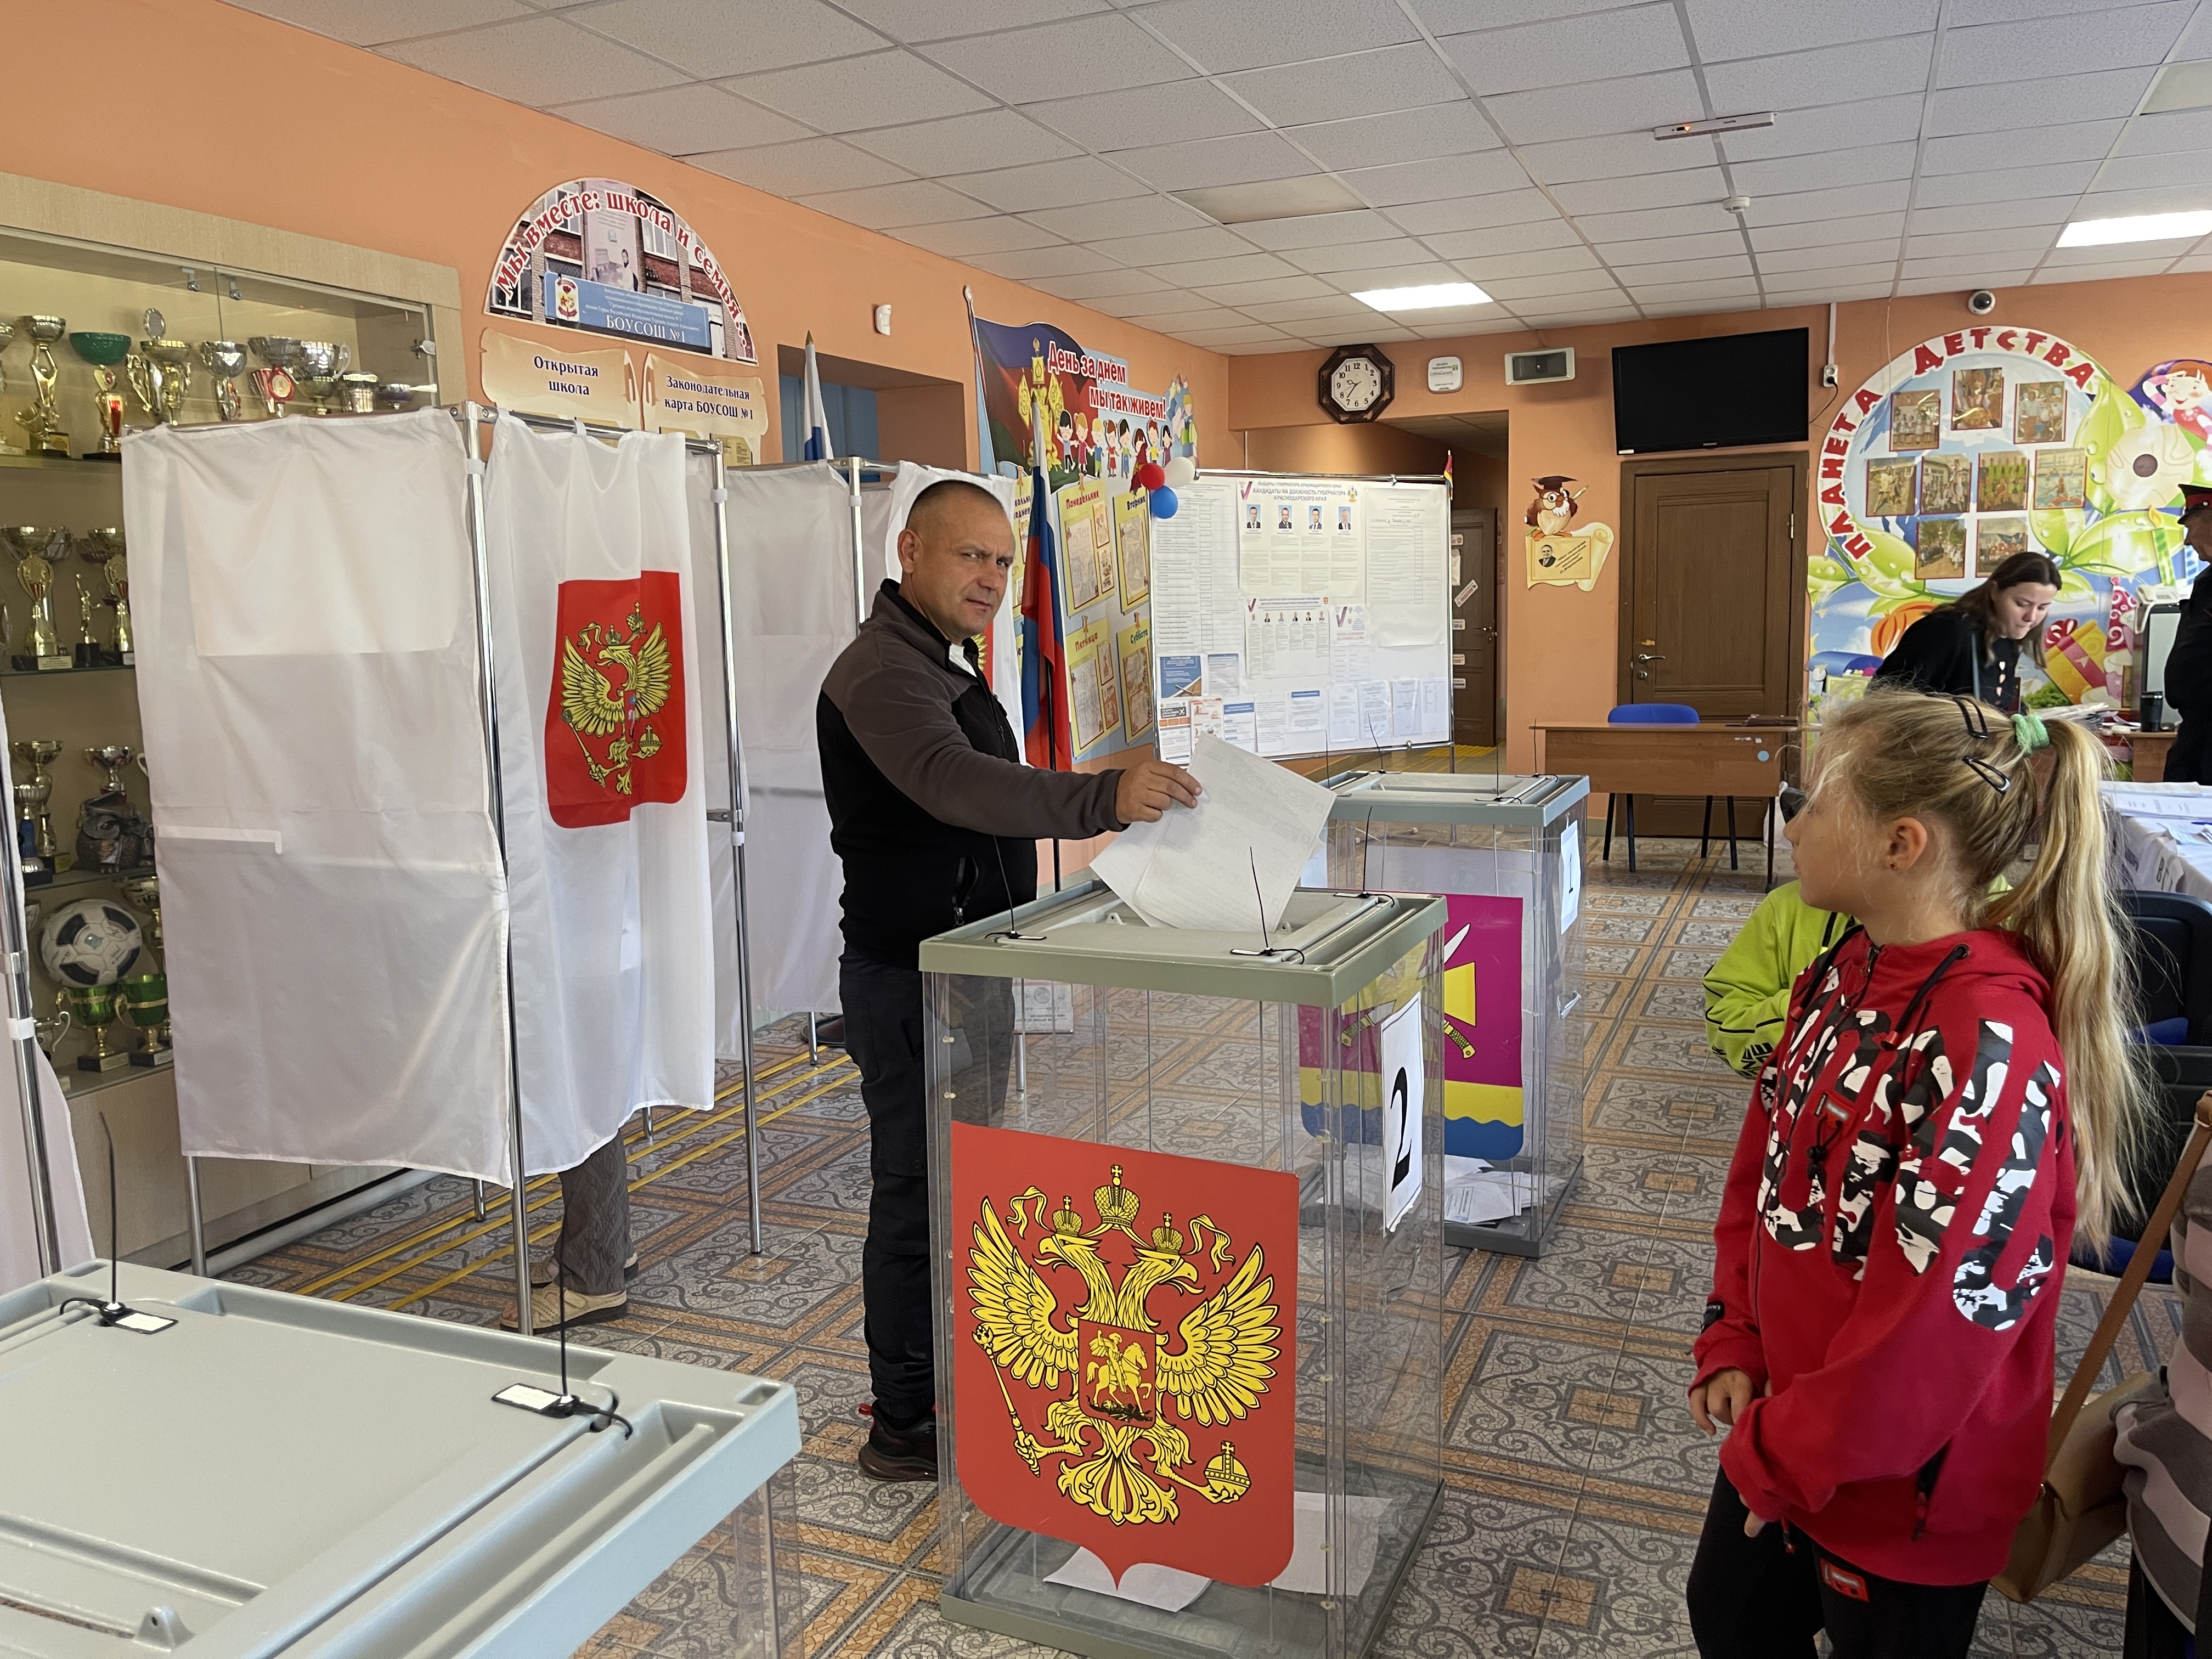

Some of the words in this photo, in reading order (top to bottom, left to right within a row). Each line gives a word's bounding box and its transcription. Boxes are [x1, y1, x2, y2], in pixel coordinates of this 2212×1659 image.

[496, 246, 528, 297] Мы
[525, 193, 600, 247] вместе:
[606, 193, 671, 233] школа
[678, 228, 689, 247] и
[606, 314, 666, 339] БОУСОШ
[669, 328, 685, 342] №1
[534, 356, 599, 377] Открытая
[1049, 342, 1079, 373] День
[1081, 357, 1095, 377] за
[1098, 359, 1126, 383] днём
[549, 381, 590, 396] школа
[666, 376, 750, 400] Законодательная
[664, 398, 694, 412] карта
[696, 401, 738, 417] БОУСОШ
[1110, 391, 1128, 411] так
[1821, 388, 1882, 560] ПЛАНЕТА
[1915, 328, 2095, 389] ДЕТСТВА
[1066, 490, 1099, 510] Понедельник
[1127, 496, 1146, 511] Вторник
[1075, 633, 1098, 652] Пятница
[1131, 629, 1148, 644] Суббота
[1568, 854, 1573, 894] 1
[1390, 1067, 1412, 1193] 2
